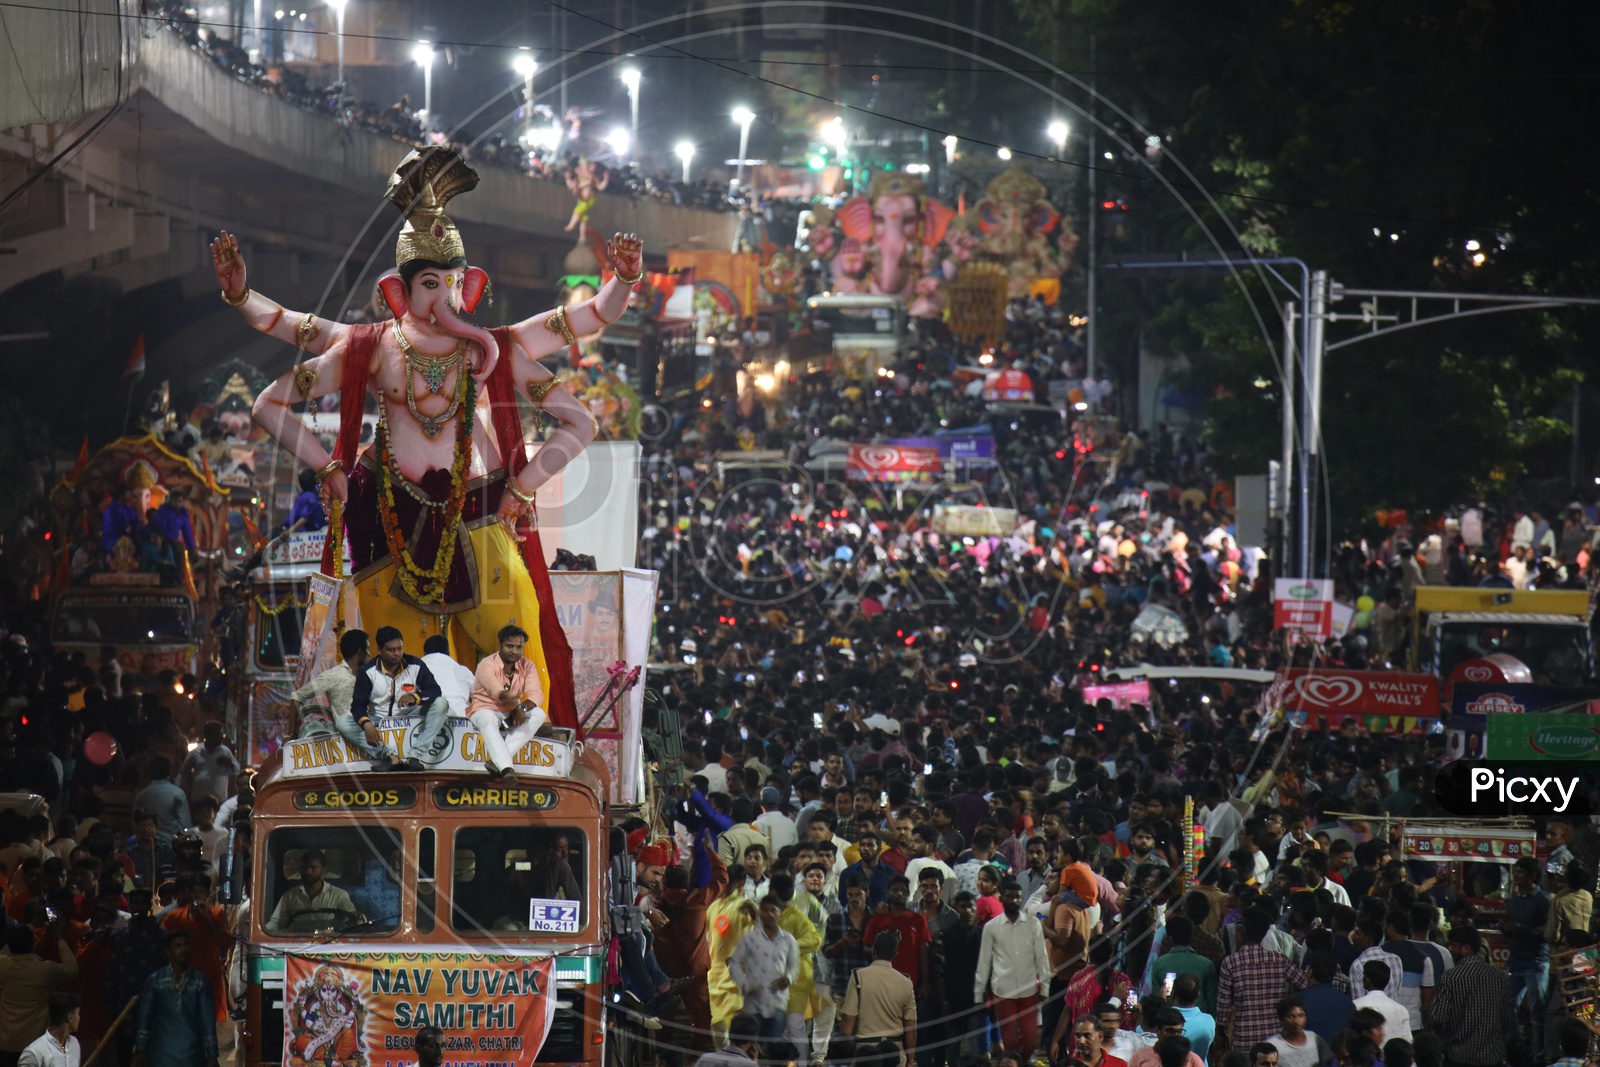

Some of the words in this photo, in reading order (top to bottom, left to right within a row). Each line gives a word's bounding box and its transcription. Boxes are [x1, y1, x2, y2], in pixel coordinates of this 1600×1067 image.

[1369, 681, 1428, 694] KWALITY
[1375, 693, 1422, 706] WALL'S
[1471, 702, 1519, 713] JERSEY
[393, 717, 411, 728] INDIA
[1538, 733, 1596, 748] Heritage
[324, 790, 399, 807] GOODS
[446, 788, 529, 806] CARRIER
[1419, 841, 1430, 850] 20
[1448, 842, 1459, 852] 30
[1478, 843, 1488, 852] 40
[1508, 844, 1519, 853] 50
[371, 968, 432, 995] NAV
[441, 969, 541, 996] YUVAK
[394, 1001, 515, 1029] SAMITHI
[478, 1036, 522, 1050] CHATRI
